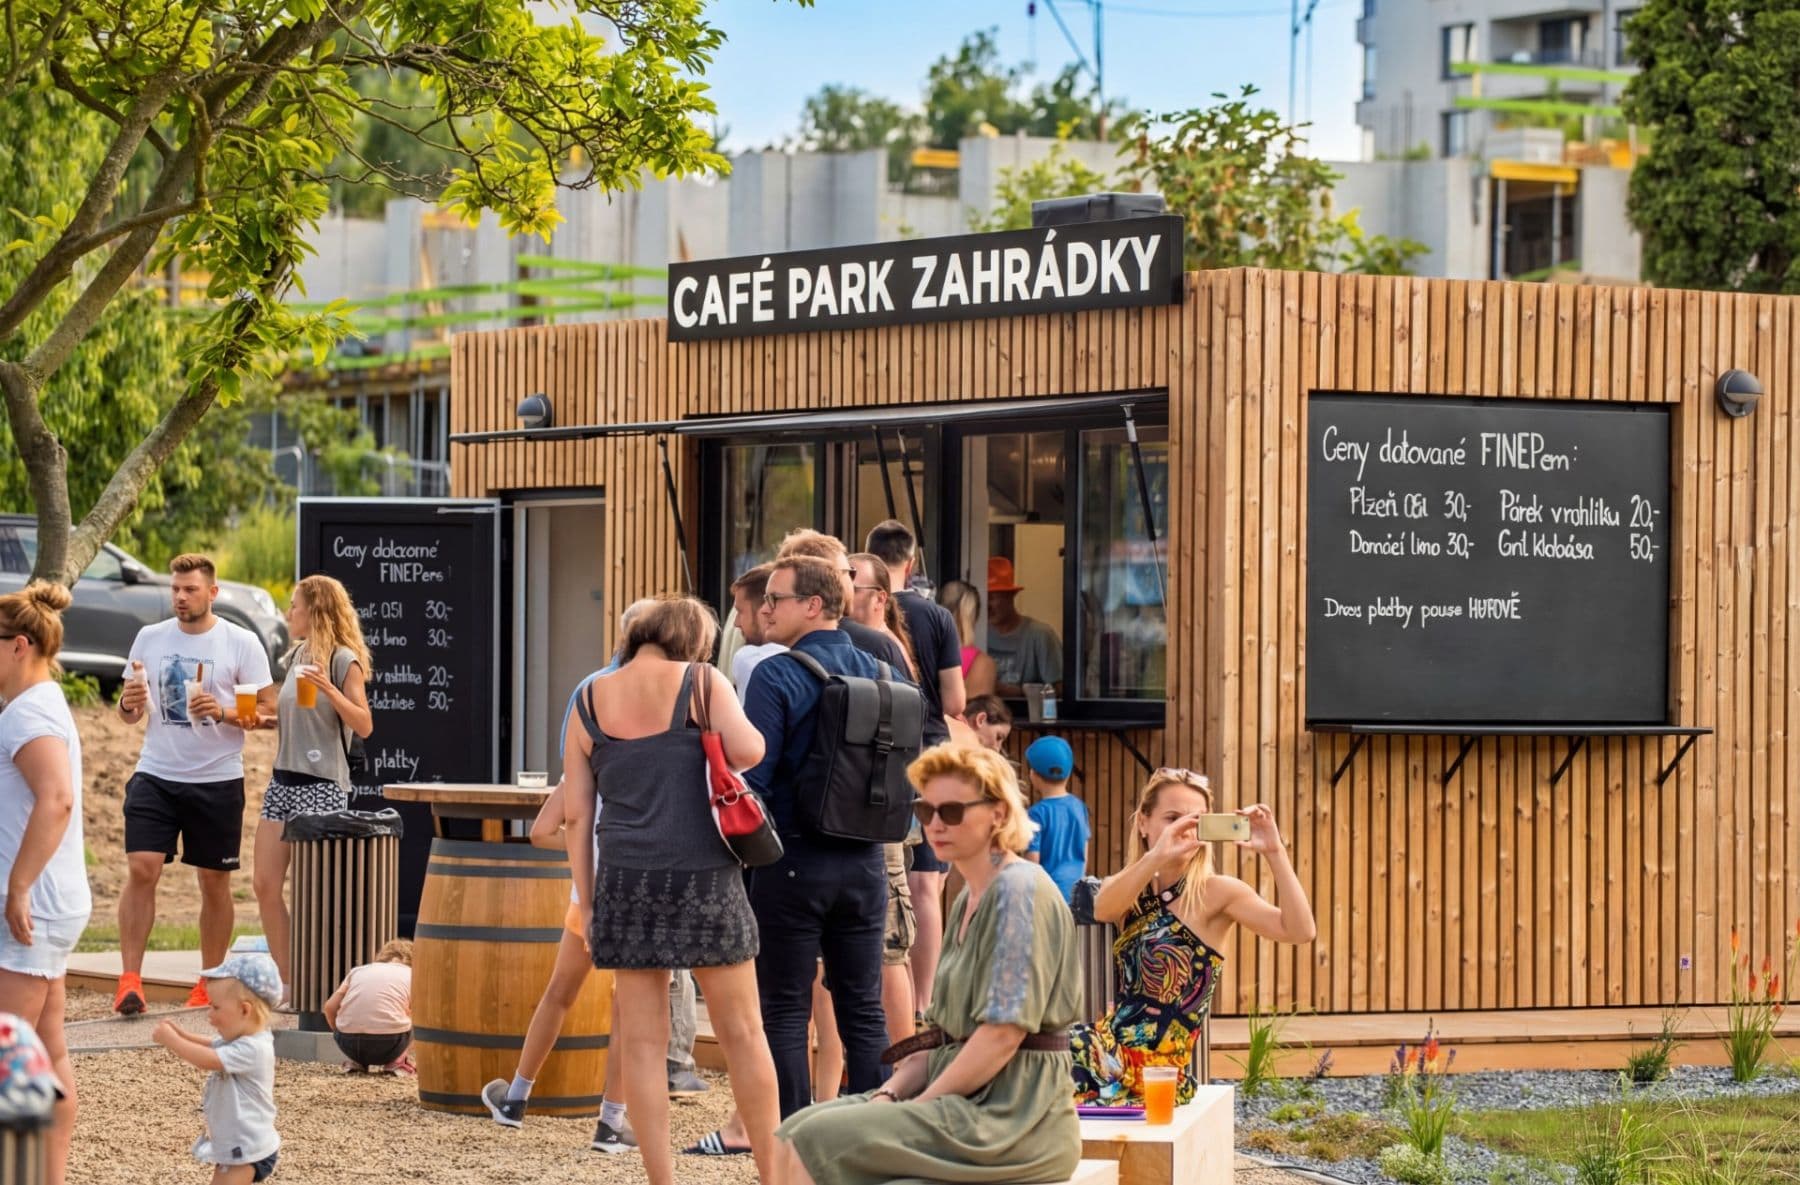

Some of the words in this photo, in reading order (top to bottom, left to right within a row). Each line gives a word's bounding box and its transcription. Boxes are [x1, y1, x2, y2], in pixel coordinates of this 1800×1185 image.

[674, 257, 774, 328] CAFÉ
[789, 259, 894, 319] PARK
[911, 229, 1161, 309] ZAHRÁDKY
[1323, 426, 1369, 481] Ceny
[1380, 427, 1465, 465] dotované
[1350, 486, 1398, 517] Plzeň
[1444, 491, 1471, 522] 30,-
[1500, 490, 1543, 523] Párek
[1630, 495, 1660, 532] 20,-
[1447, 532, 1474, 559] 30,-
[1631, 533, 1659, 562] 50,-
